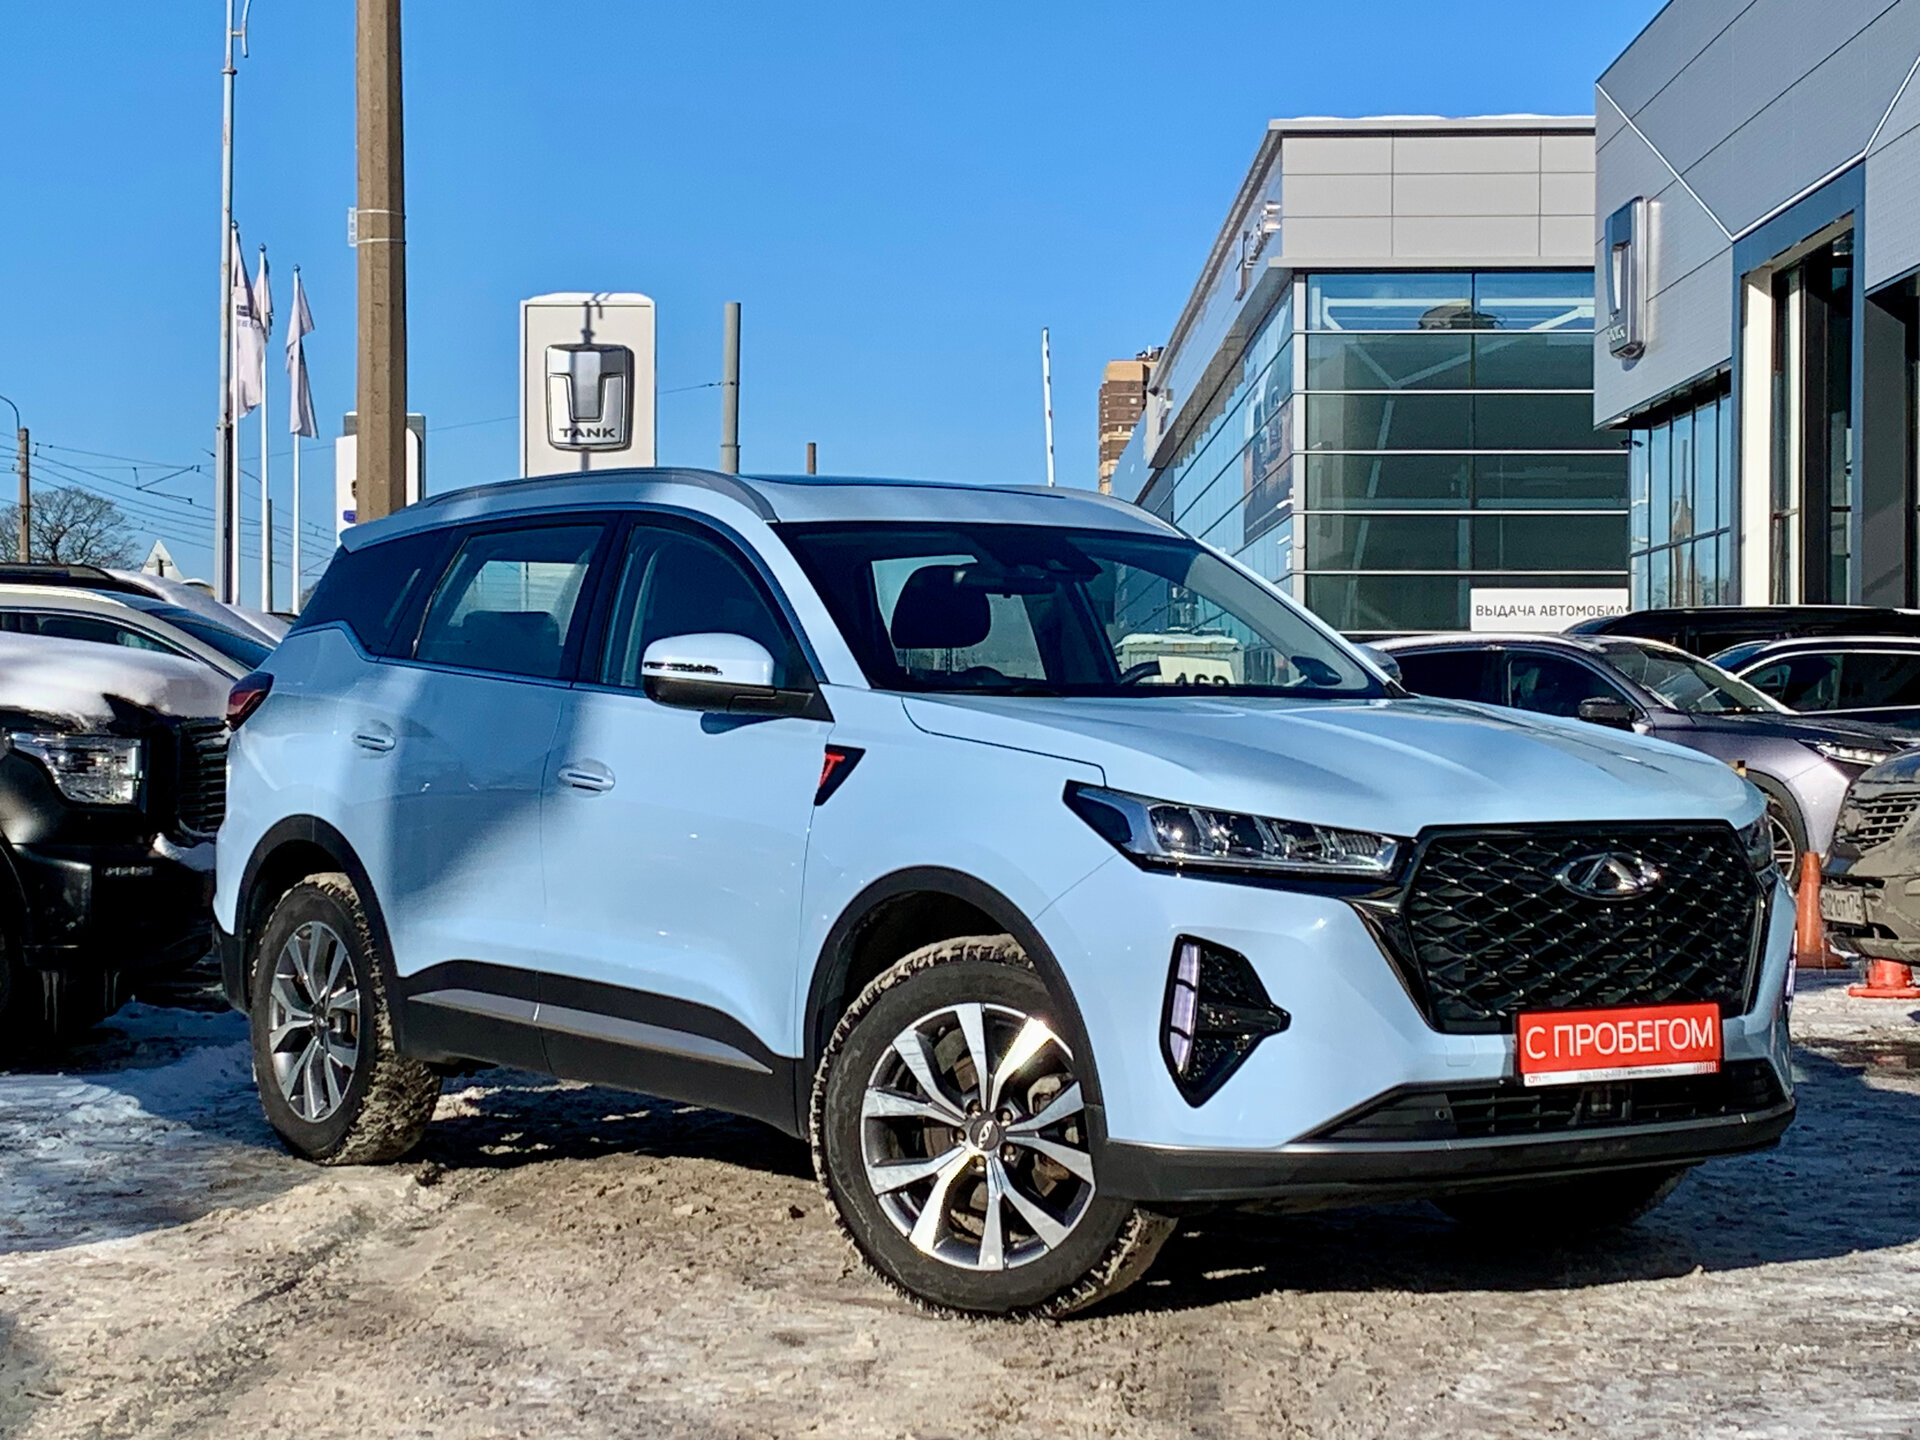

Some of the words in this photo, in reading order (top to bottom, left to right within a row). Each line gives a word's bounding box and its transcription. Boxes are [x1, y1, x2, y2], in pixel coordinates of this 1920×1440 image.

[559, 427, 616, 438] TANK
[1475, 604, 1536, 618] ВЫДАЧА
[1525, 1026, 1546, 1059] С
[1553, 1016, 1713, 1058] ПРОБЕГОМ
